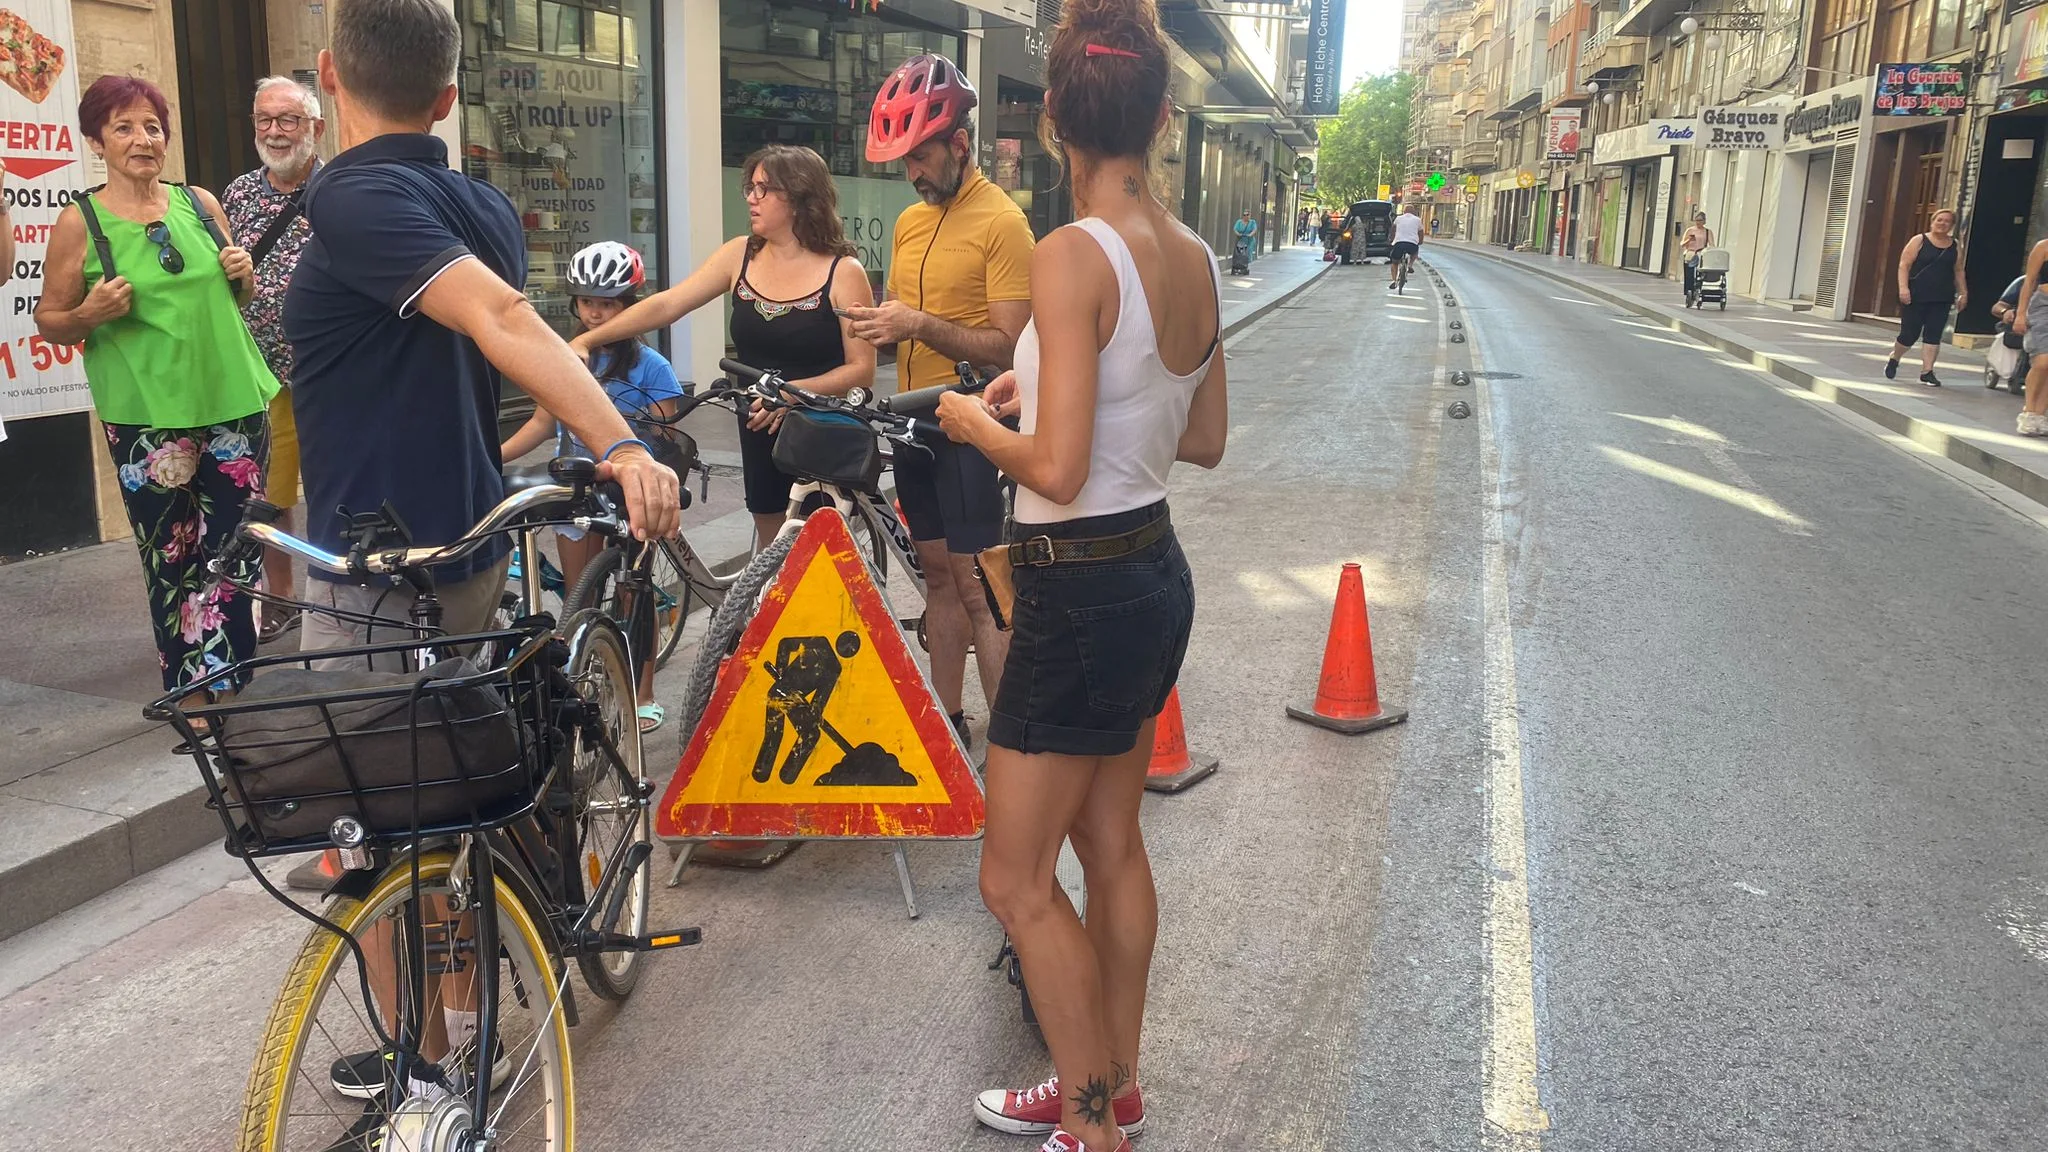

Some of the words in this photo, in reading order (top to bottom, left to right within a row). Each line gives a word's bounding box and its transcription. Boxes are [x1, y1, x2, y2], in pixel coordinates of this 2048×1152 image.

[1024, 28, 1052, 60] Re-Re
[1315, 39, 1328, 70] Elche
[500, 69, 548, 91] PIDE
[553, 69, 604, 93] AQUI
[1886, 68, 1904, 84] La
[1907, 67, 1962, 85] Guarida
[1312, 73, 1325, 103] Hotel
[1877, 93, 1894, 108] de
[1896, 92, 1917, 109] las
[1919, 92, 1966, 113] Brujas
[585, 105, 613, 128] UP
[1703, 108, 1778, 129] Gázquez
[1549, 119, 1560, 152] VENDE
[1657, 124, 1695, 140] Prieto
[1711, 128, 1766, 143] Bravo
[522, 177, 605, 191] PUBLIDAD
[47, 189, 79, 208] LO
[21, 386, 48, 396] VÁLIDO
[49, 385, 60, 393] EN
